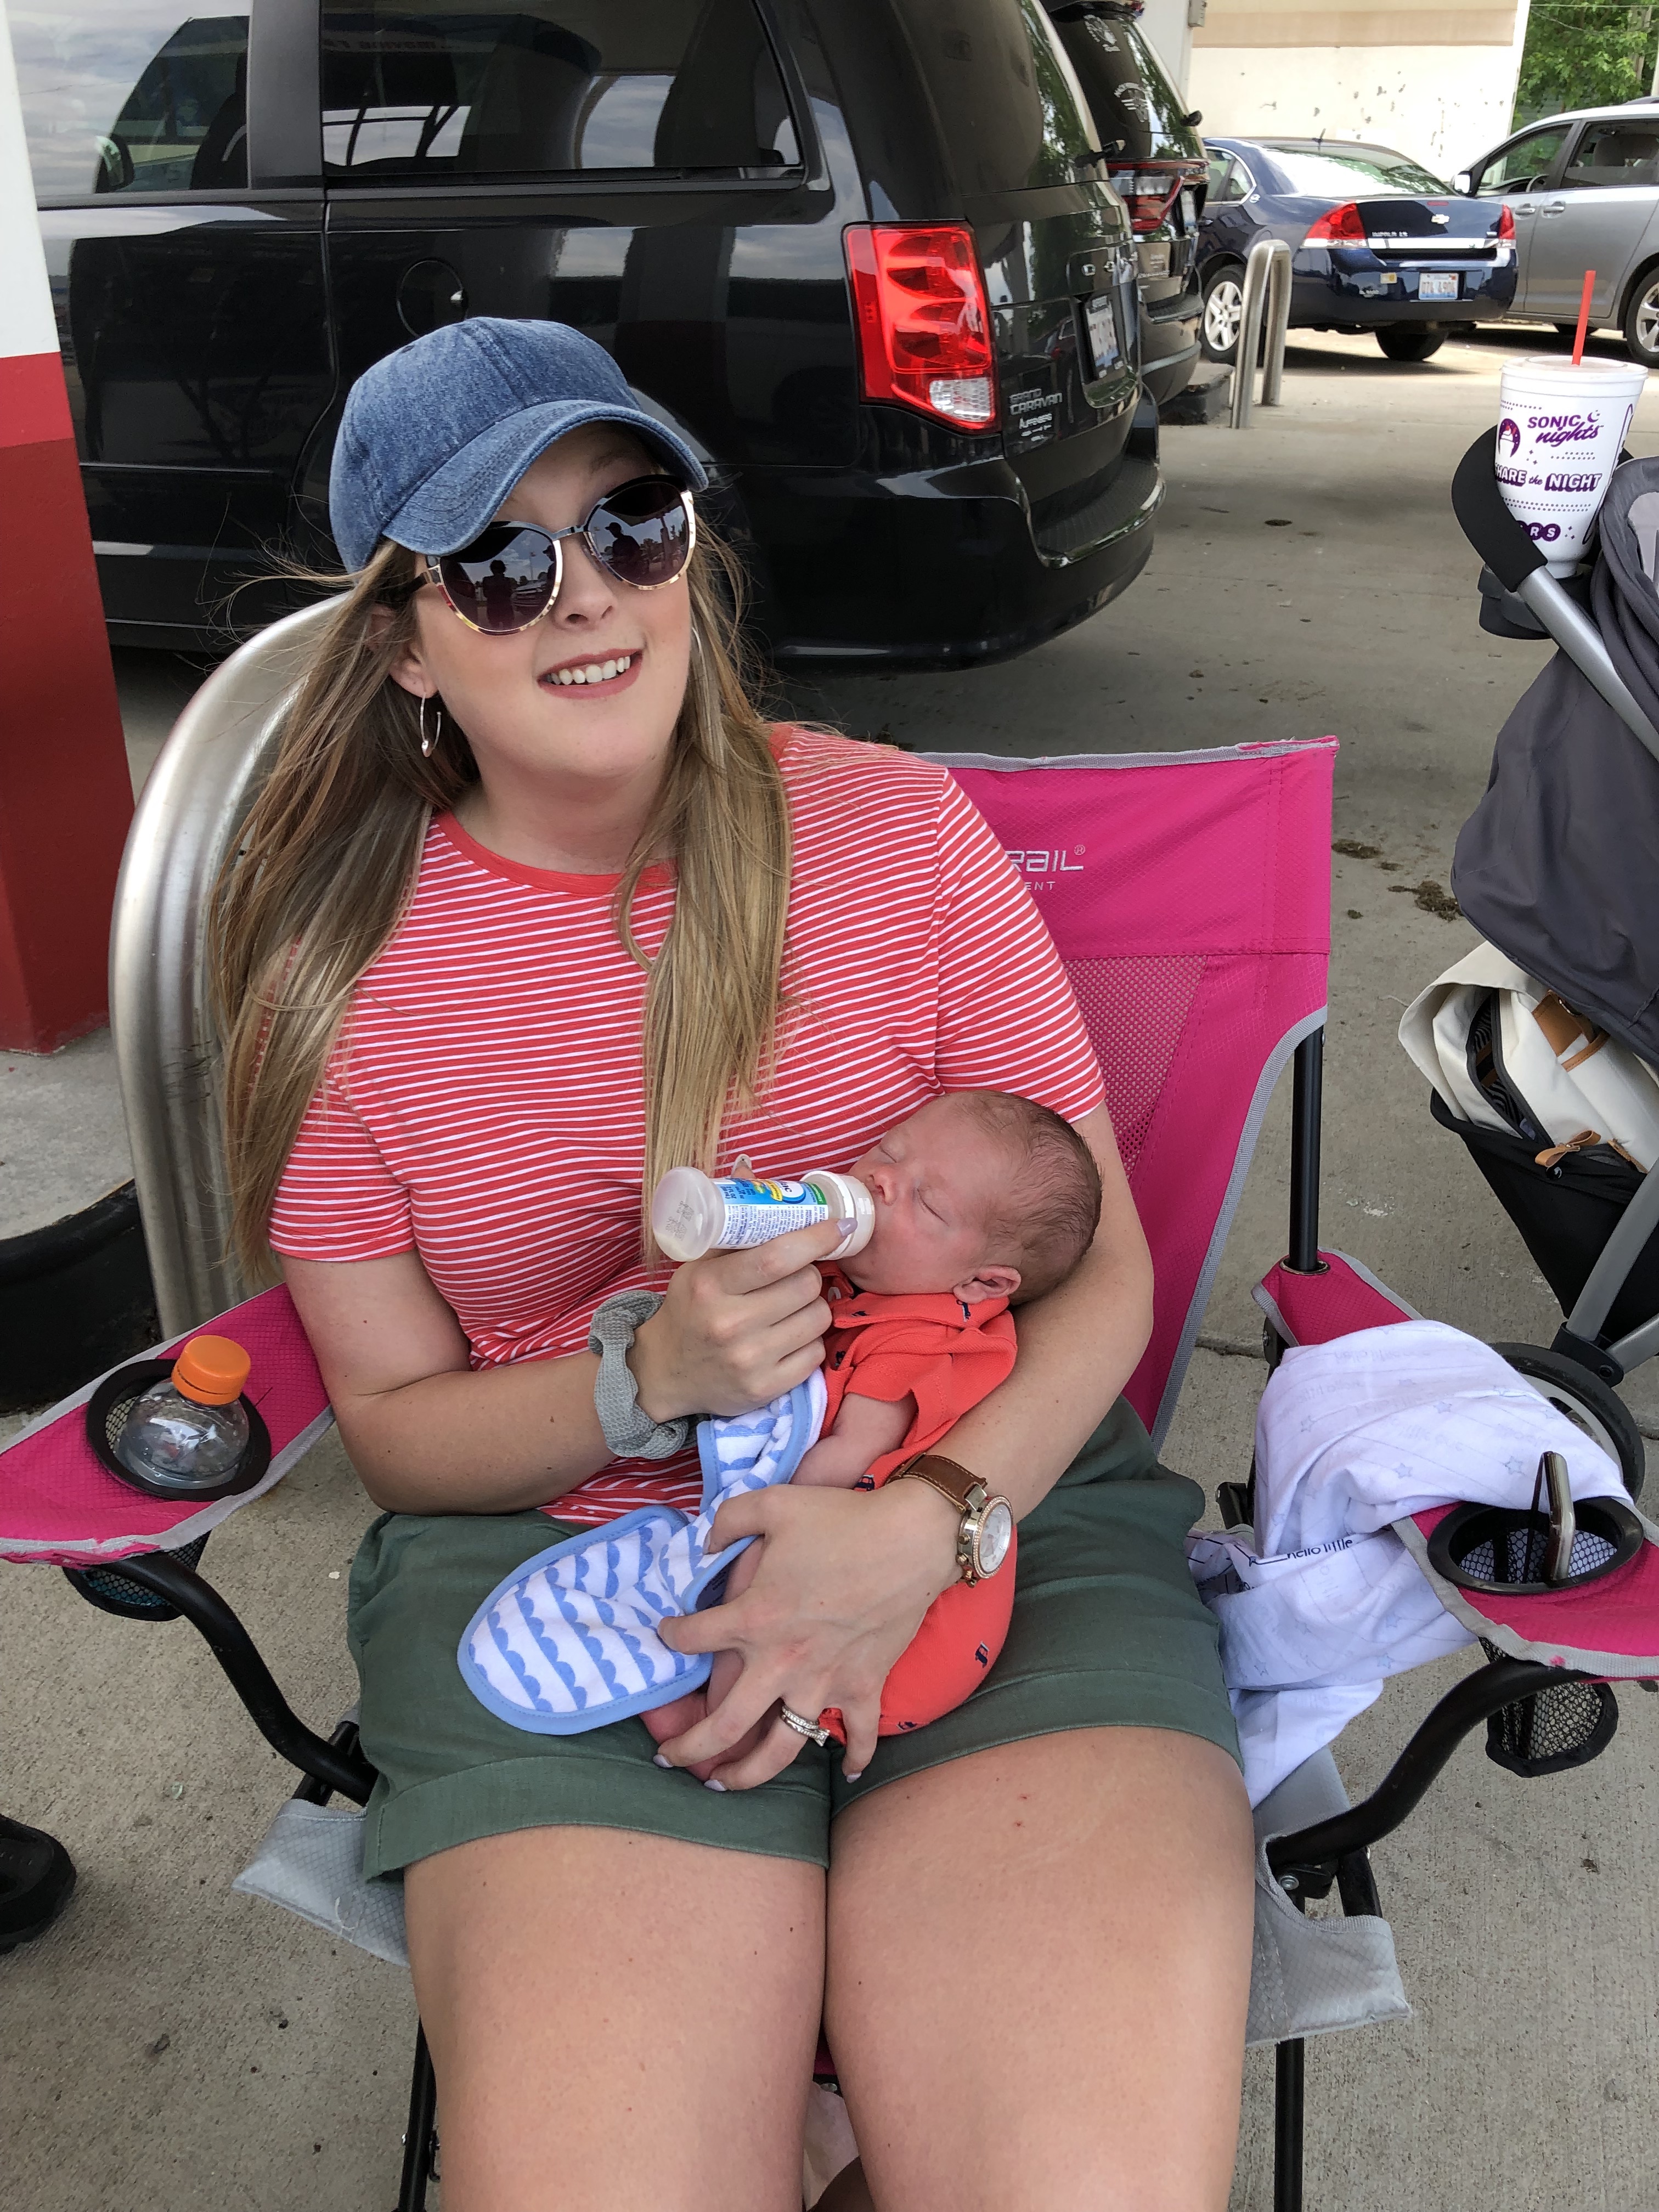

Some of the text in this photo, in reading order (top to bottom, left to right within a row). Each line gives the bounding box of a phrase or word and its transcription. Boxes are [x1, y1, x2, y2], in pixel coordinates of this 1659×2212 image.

[1009, 392, 1063, 415] CARAVAN
[1527, 415, 1581, 429] SONIC
[1536, 421, 1602, 447] nights
[1495, 464, 1602, 492] HARE the NIGHT
